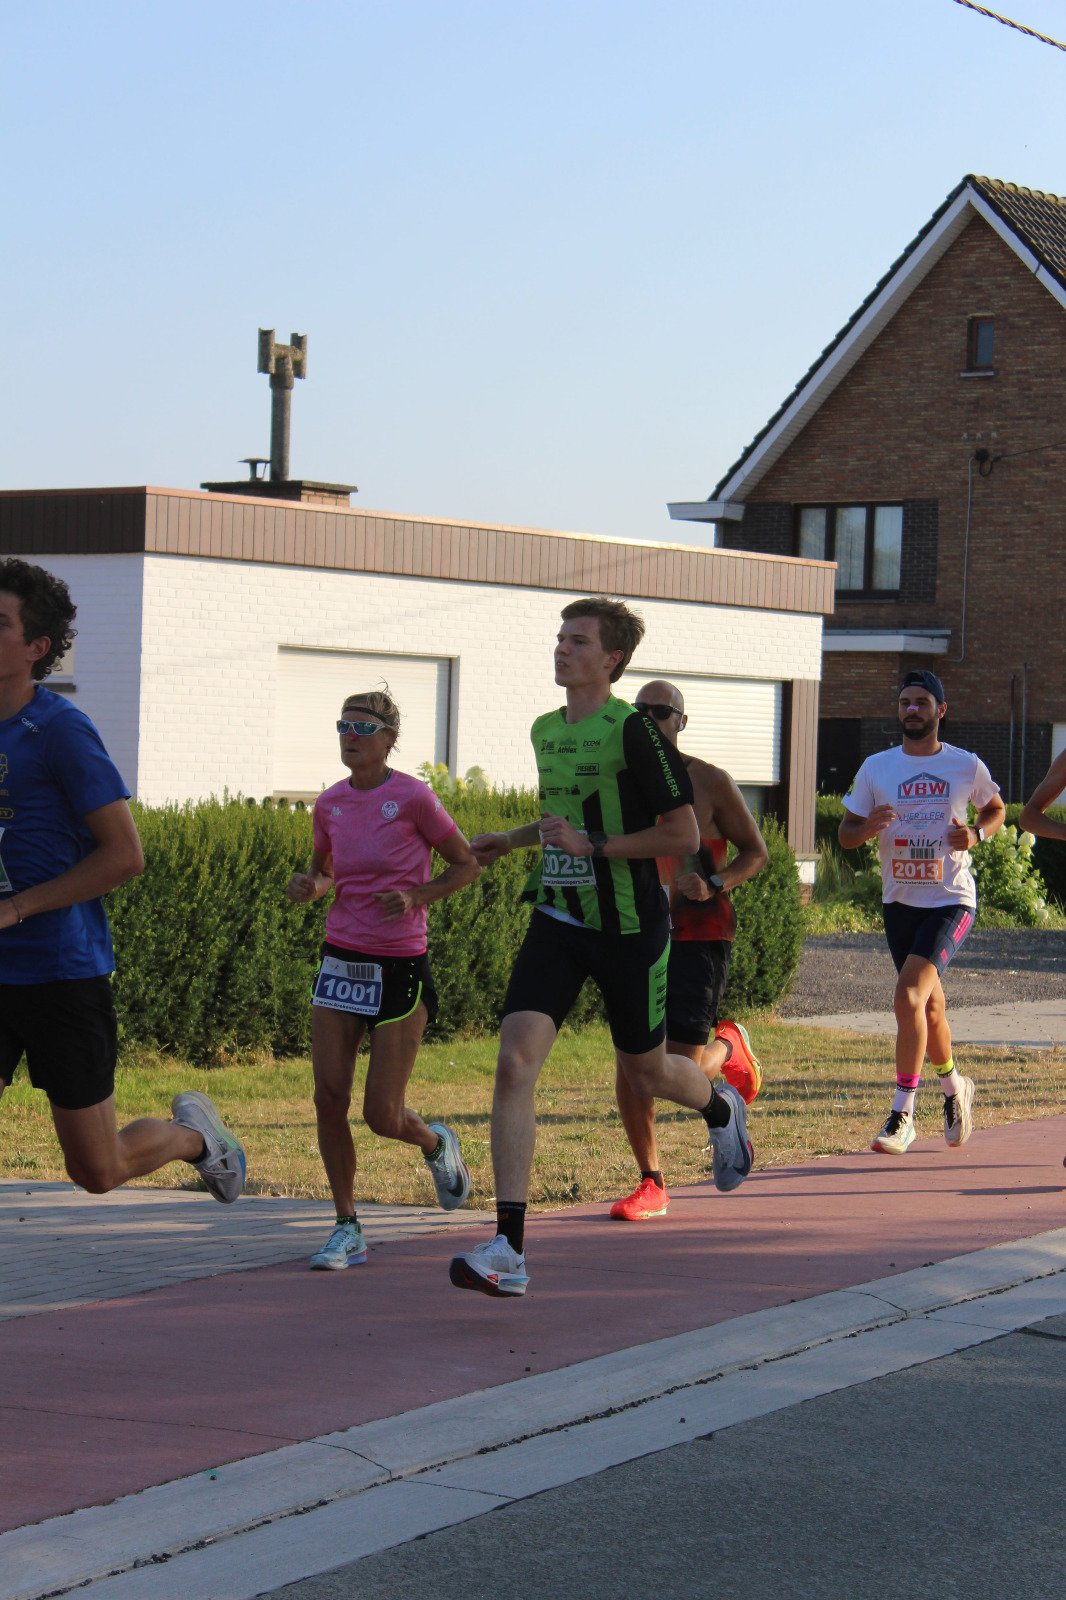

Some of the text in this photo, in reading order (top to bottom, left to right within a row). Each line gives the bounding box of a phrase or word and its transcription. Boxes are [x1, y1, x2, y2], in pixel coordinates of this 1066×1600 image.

[642, 716, 681, 798] LUCKY RUNNERS
[901, 782, 946, 796] VBW
[543, 853, 588, 875] 3025
[894, 861, 939, 878] 2013
[323, 978, 376, 1004] 1001
